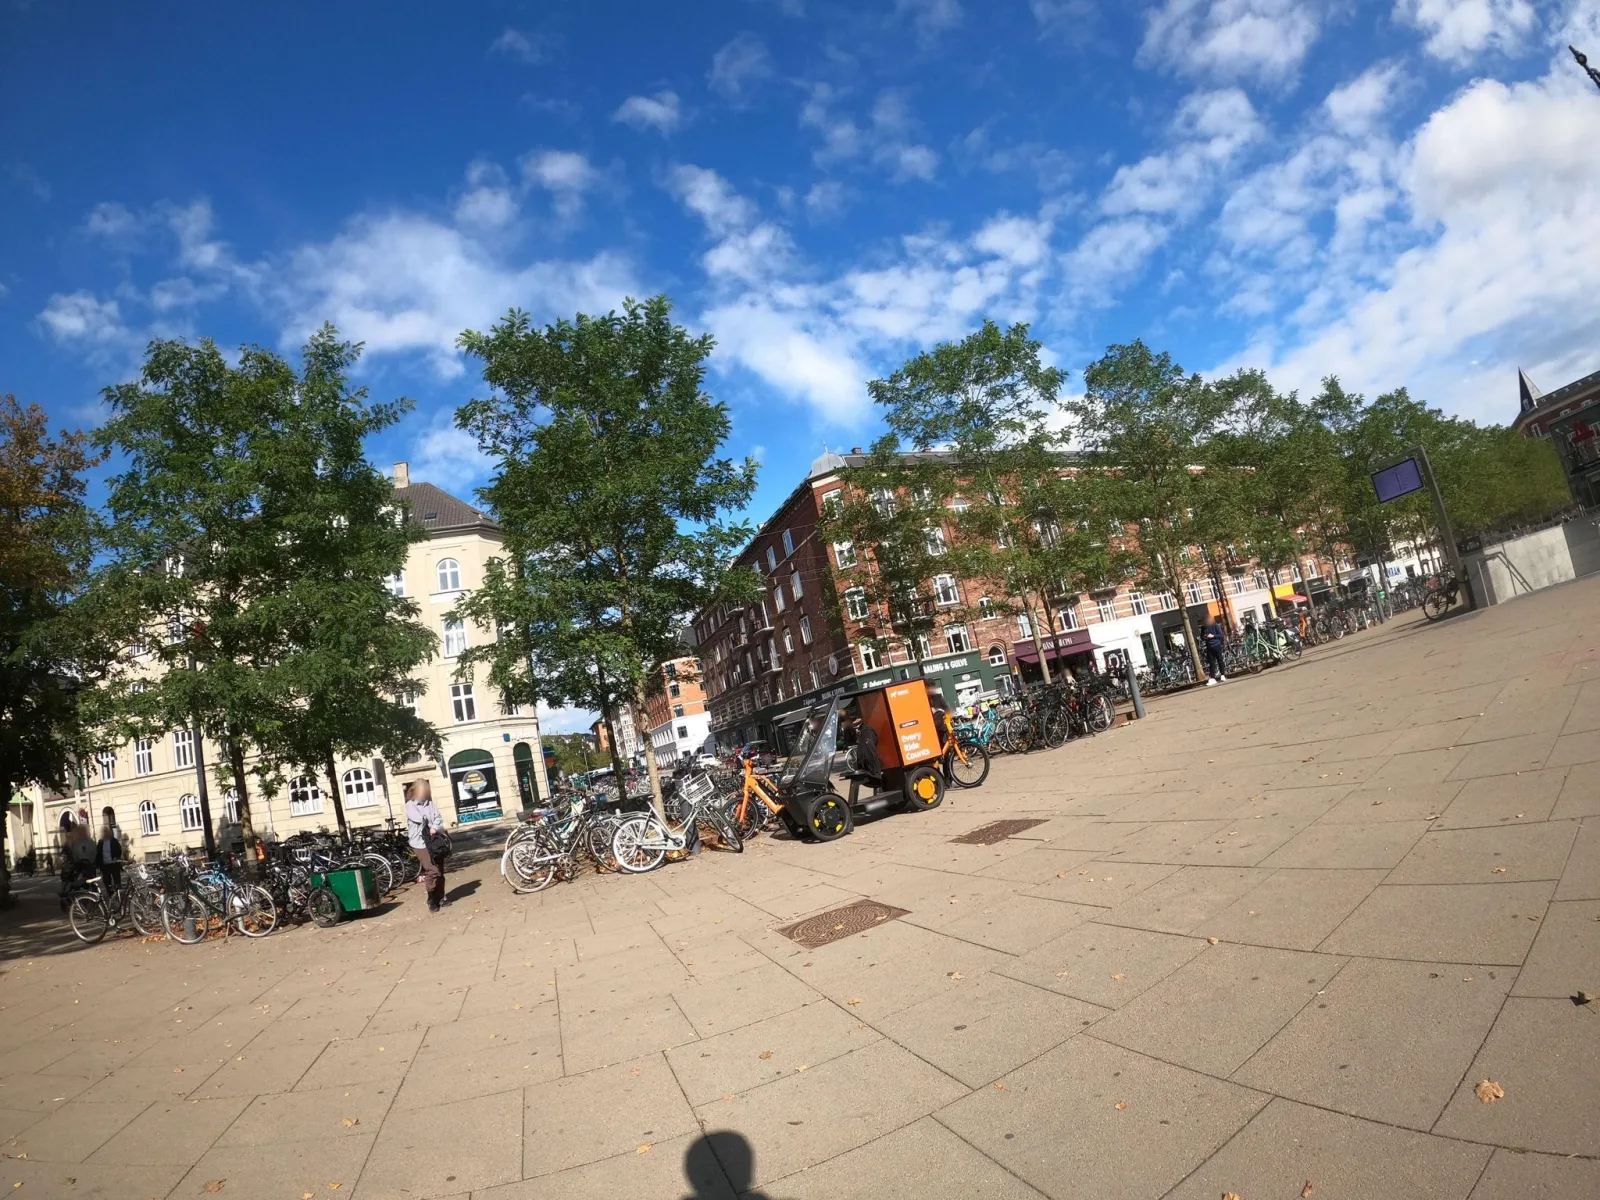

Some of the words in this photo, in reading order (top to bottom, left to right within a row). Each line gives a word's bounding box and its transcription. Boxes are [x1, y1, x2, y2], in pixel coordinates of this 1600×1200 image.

[901, 732, 922, 743] Every
[904, 742, 920, 751] Ride
[906, 749, 931, 760] Counts
